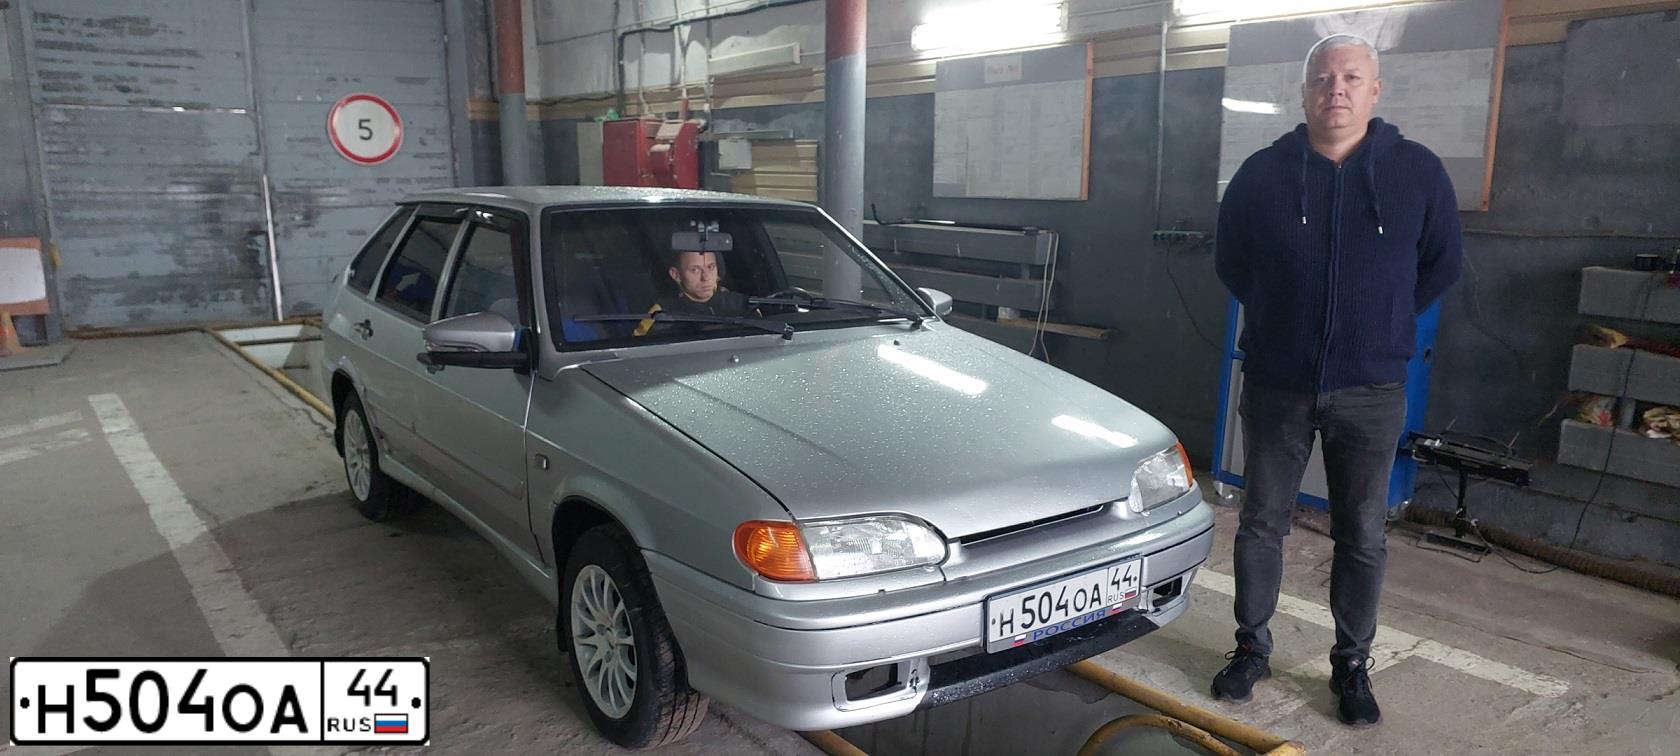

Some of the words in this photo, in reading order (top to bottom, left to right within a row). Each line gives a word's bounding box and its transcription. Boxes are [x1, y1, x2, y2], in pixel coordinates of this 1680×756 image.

[358, 118, 373, 141] 5
[1111, 564, 1132, 591] 44
[1107, 591, 1124, 603] RUS
[1033, 611, 1106, 641] РОССИЯ
